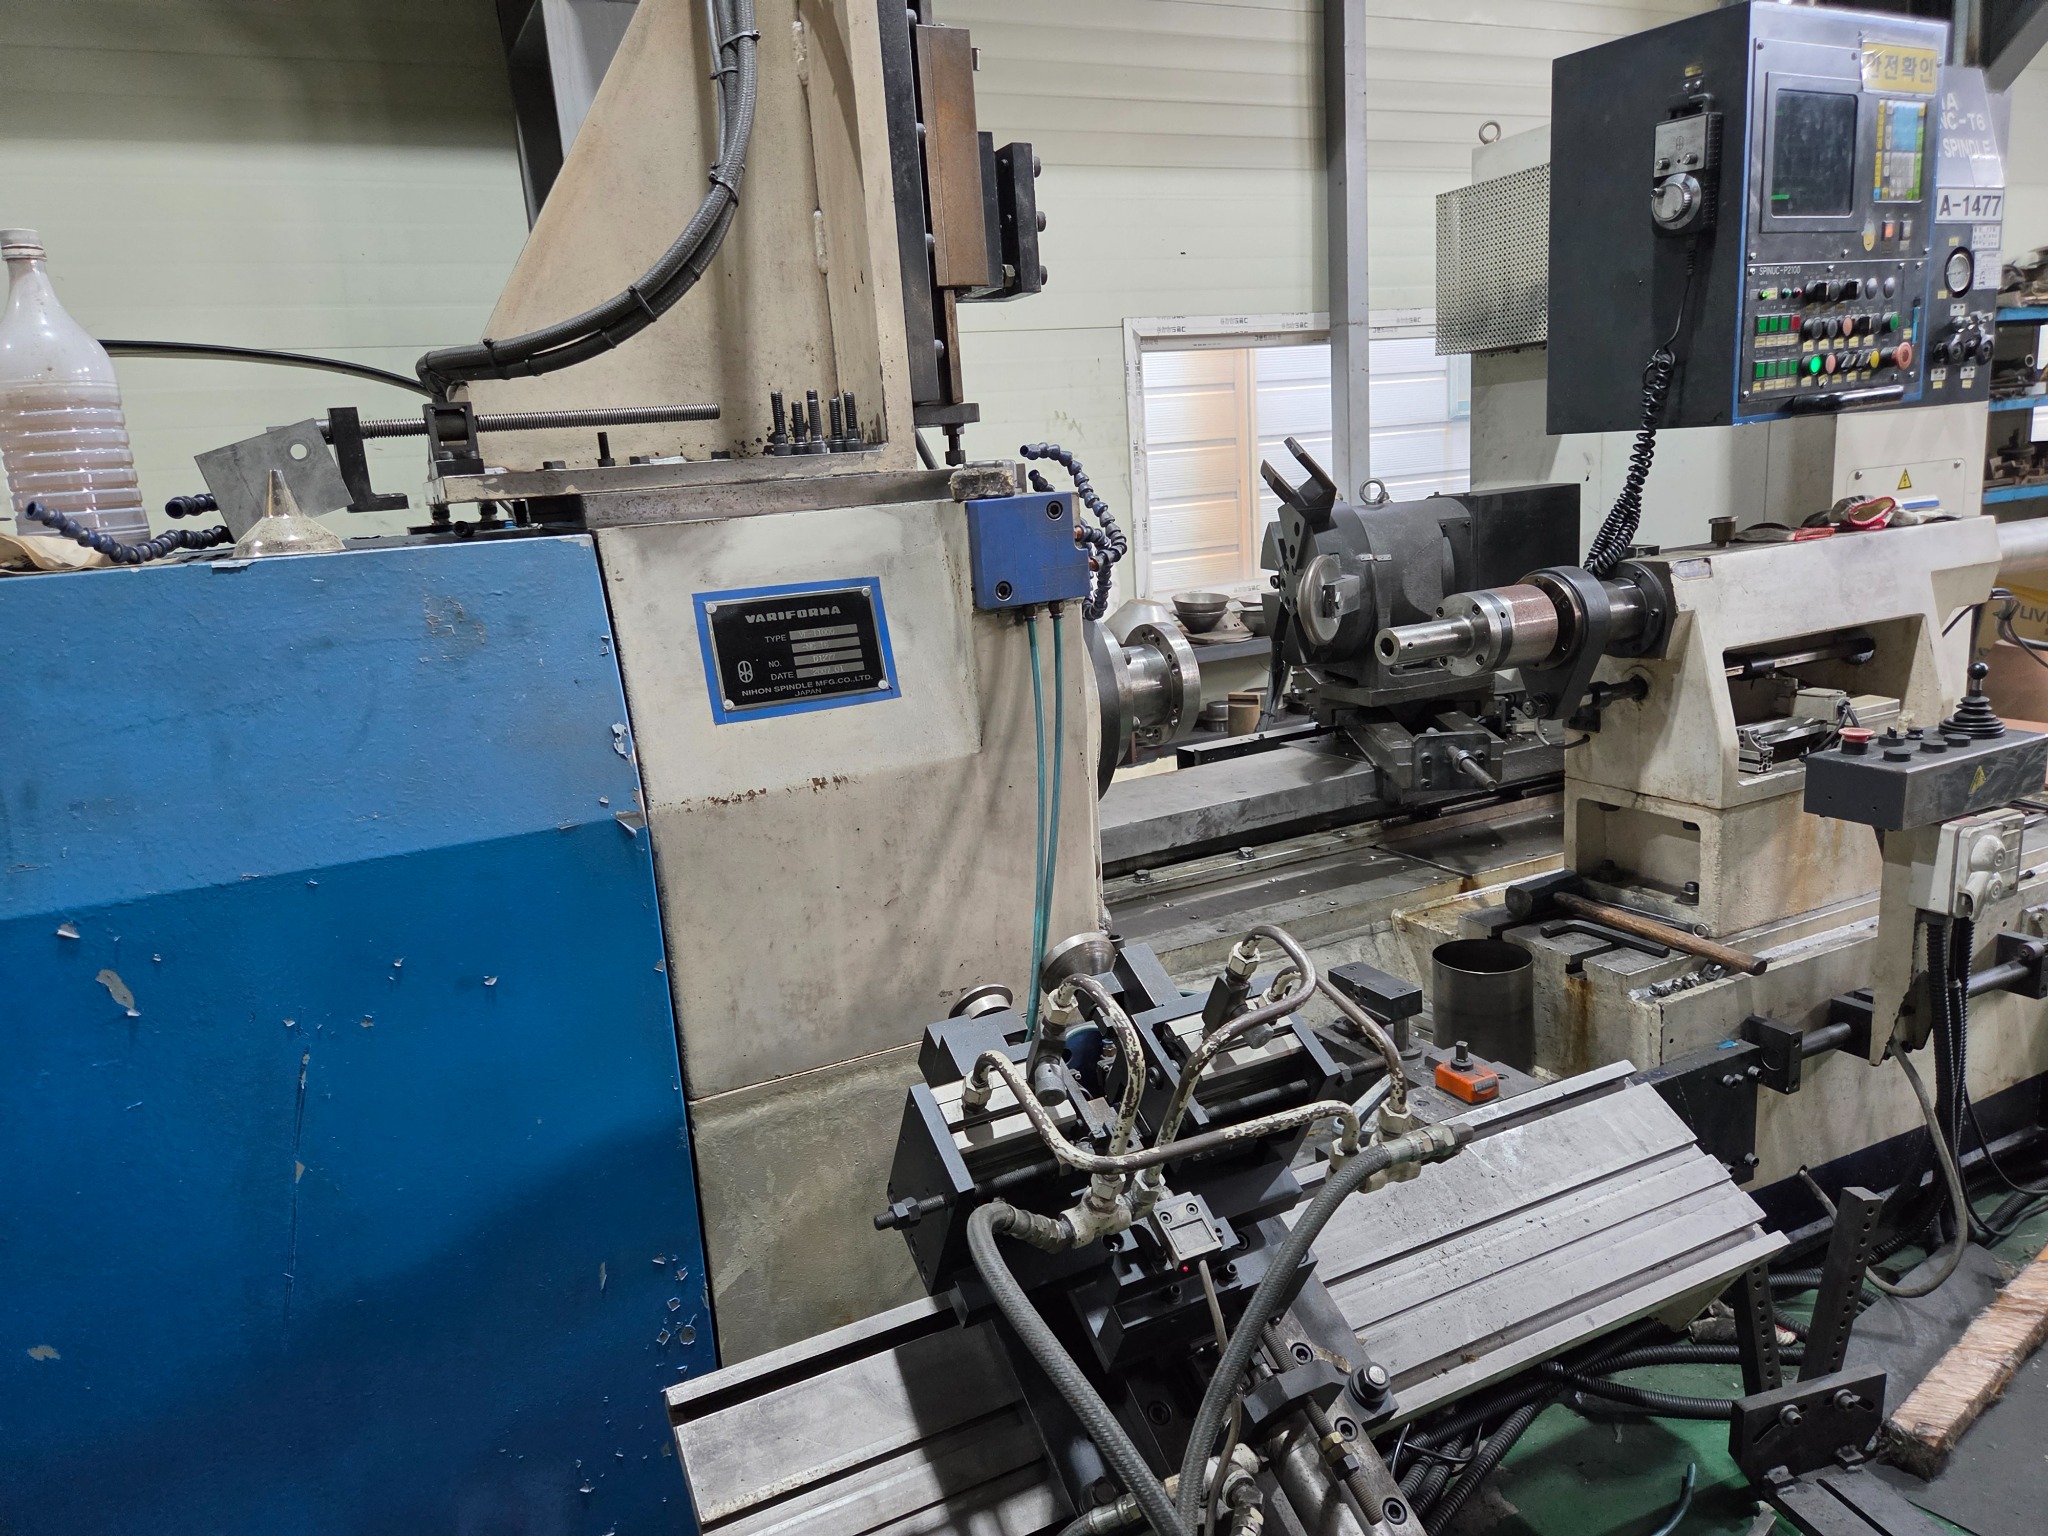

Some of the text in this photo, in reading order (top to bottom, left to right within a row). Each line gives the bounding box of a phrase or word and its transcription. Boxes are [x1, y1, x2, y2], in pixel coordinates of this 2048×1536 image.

[1866, 54, 1935, 84] 안전확인
[1942, 137, 1991, 158] SPINDLE
[1938, 194, 2002, 217] A-1477
[745, 606, 841, 623] VARIFORMA
[2019, 605, 2048, 624] LIV
[764, 634, 787, 643] TYPE
[768, 660, 782, 668] NO.
[770, 671, 794, 681] DATE
[741, 687, 772, 697] NIHON
[773, 679, 814, 693] SPINDLE
[794, 688, 822, 697] JAPAN
